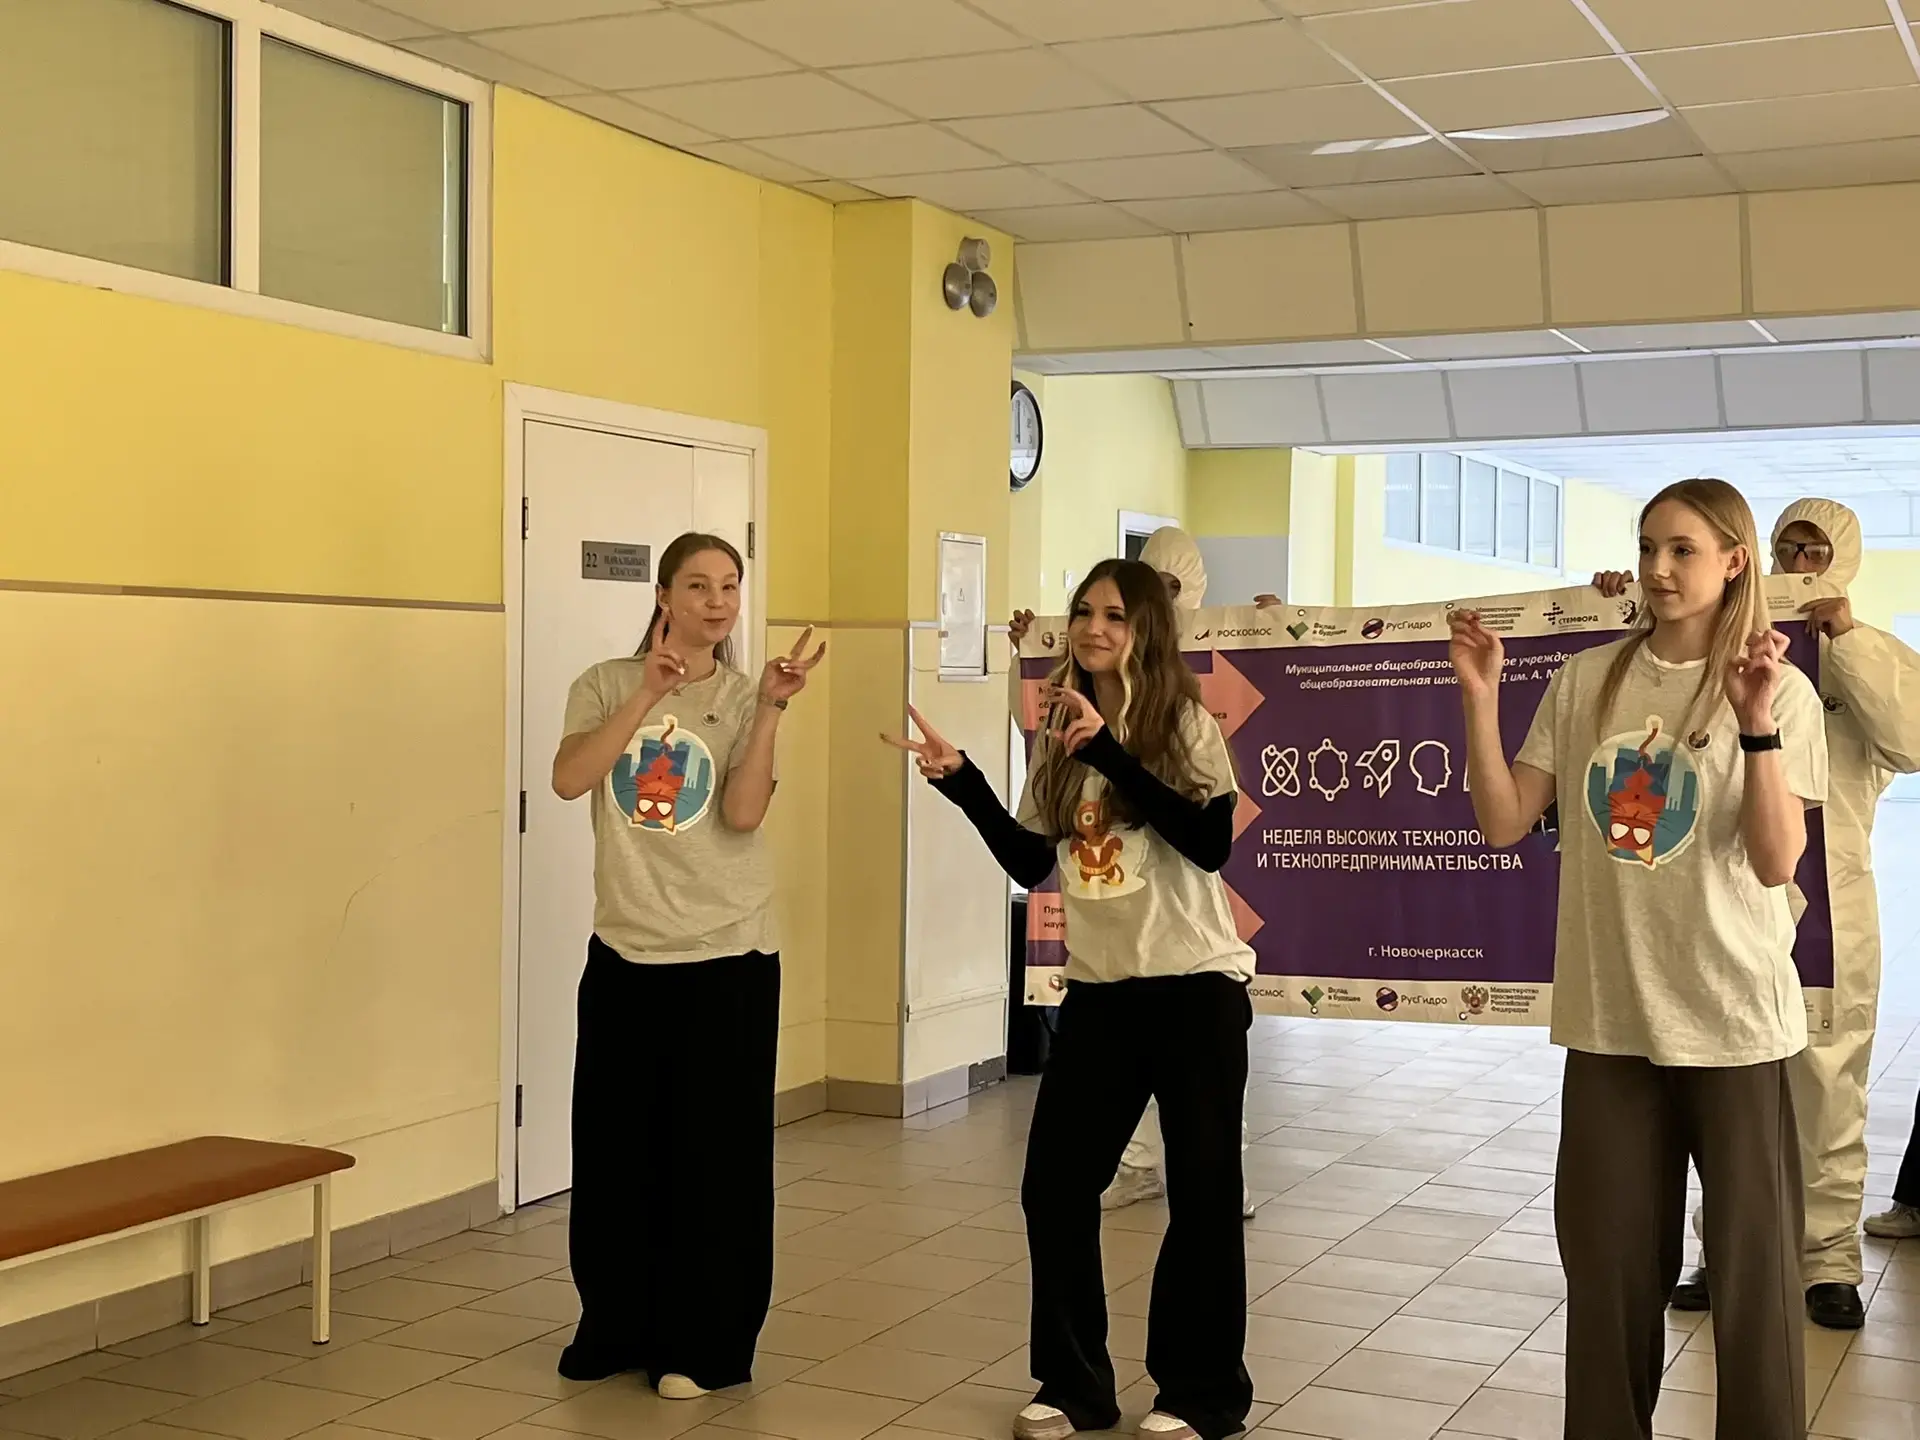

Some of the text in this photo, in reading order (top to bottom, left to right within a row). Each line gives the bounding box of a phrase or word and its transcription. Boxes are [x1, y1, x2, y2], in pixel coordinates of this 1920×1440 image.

[586, 552, 598, 568] 22
[1386, 620, 1432, 631] РусГидро
[1558, 615, 1599, 625] СТЕМФОРД
[1217, 627, 1272, 638] РОСКОСМОС
[1285, 662, 1372, 676] Муниципальное
[1502, 657, 1517, 666] ое
[1300, 675, 1431, 690] общеобразовательная
[1433, 675, 1460, 685] шко
[1510, 673, 1529, 682] им.
[1531, 669, 1543, 680] А.
[1263, 829, 1322, 847] НЕДЕЛЯ
[1327, 829, 1398, 847] ВЫСОКИХ
[1257, 852, 1524, 872] И ТЕХНОПРЕДПРИНИМАТЕЛЬСТВА
[1368, 944, 1484, 961] г. Новочеркасск
[1490, 986, 1540, 995] Министерство
[1400, 994, 1448, 1006] РусГидро
